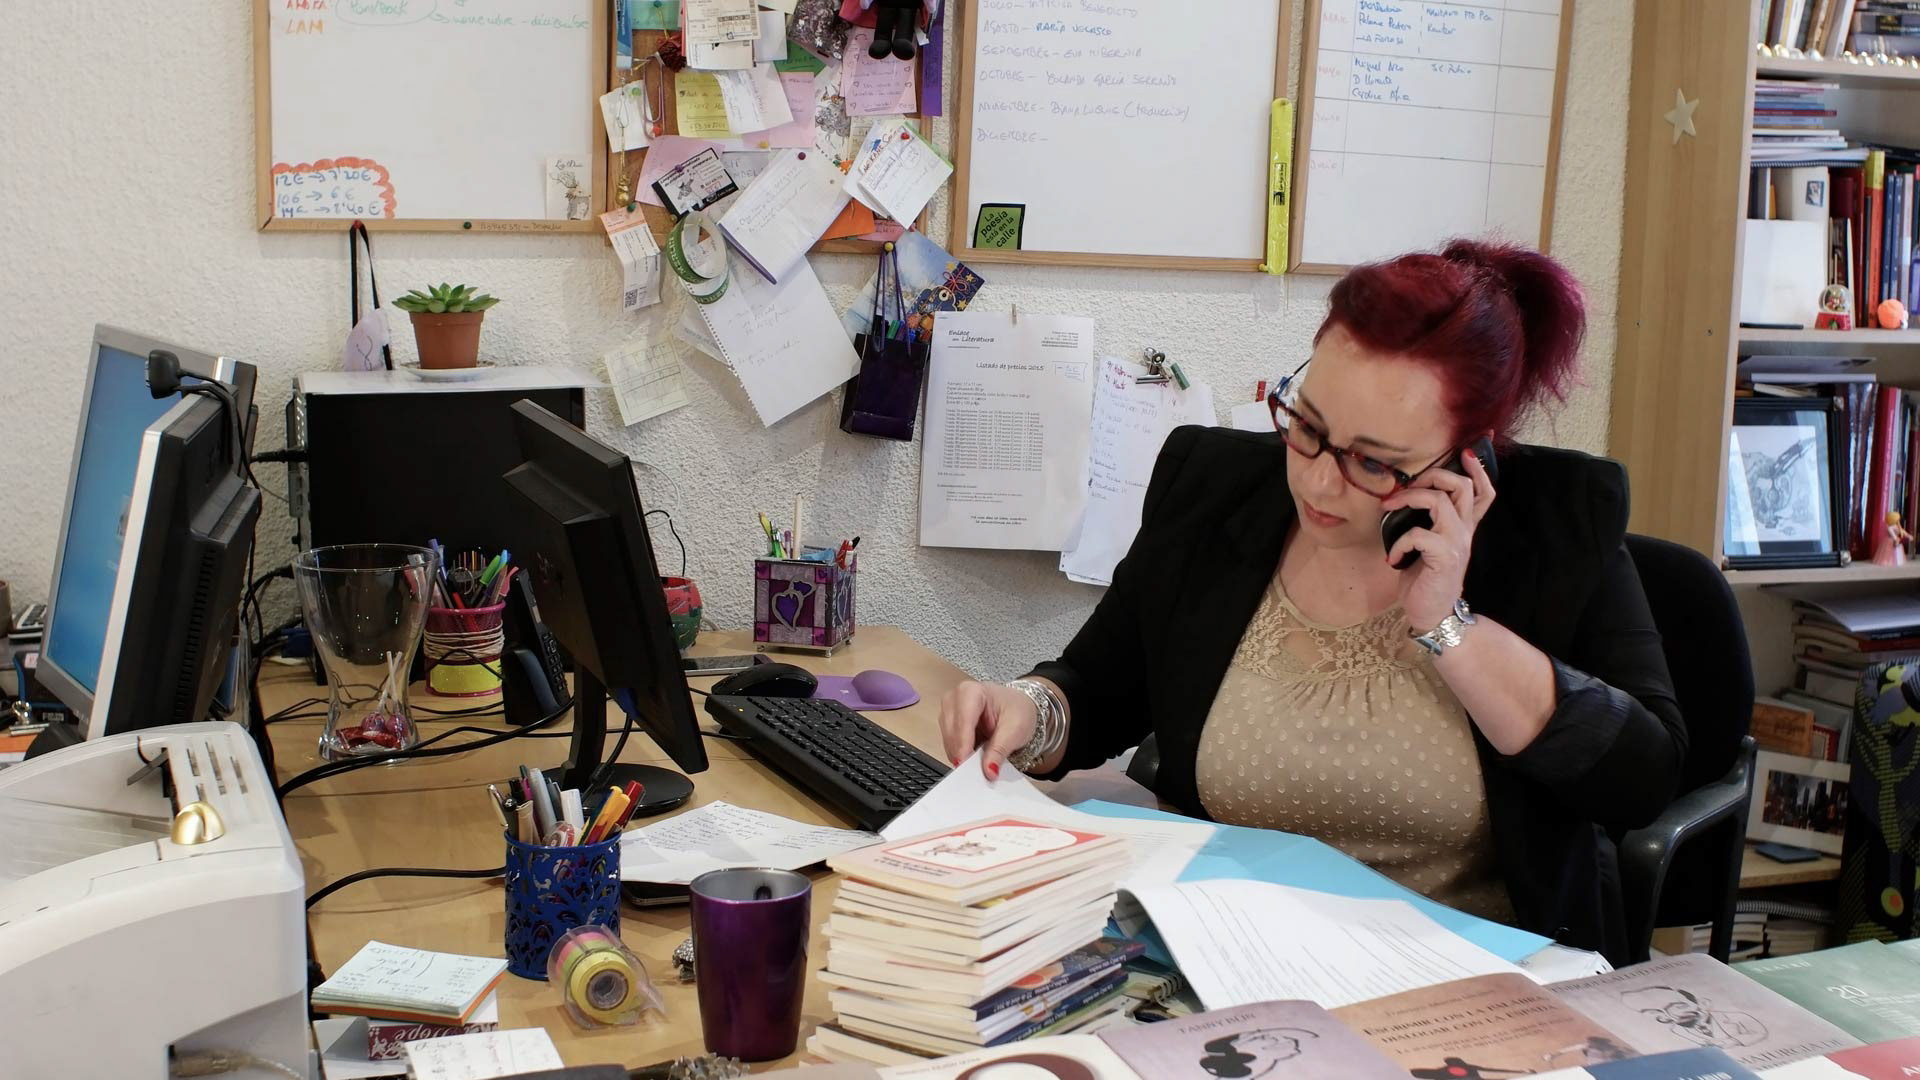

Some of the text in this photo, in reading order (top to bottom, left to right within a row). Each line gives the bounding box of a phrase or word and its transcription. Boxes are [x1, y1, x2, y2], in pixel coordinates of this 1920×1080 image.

[980, 210, 1009, 239] poesía
[984, 213, 995, 223] La
[998, 222, 1008, 232] en
[1006, 216, 1015, 225] la
[996, 228, 1016, 248] calle
[1007, 363, 1027, 371] precios
[1826, 983, 1869, 1001] 20
